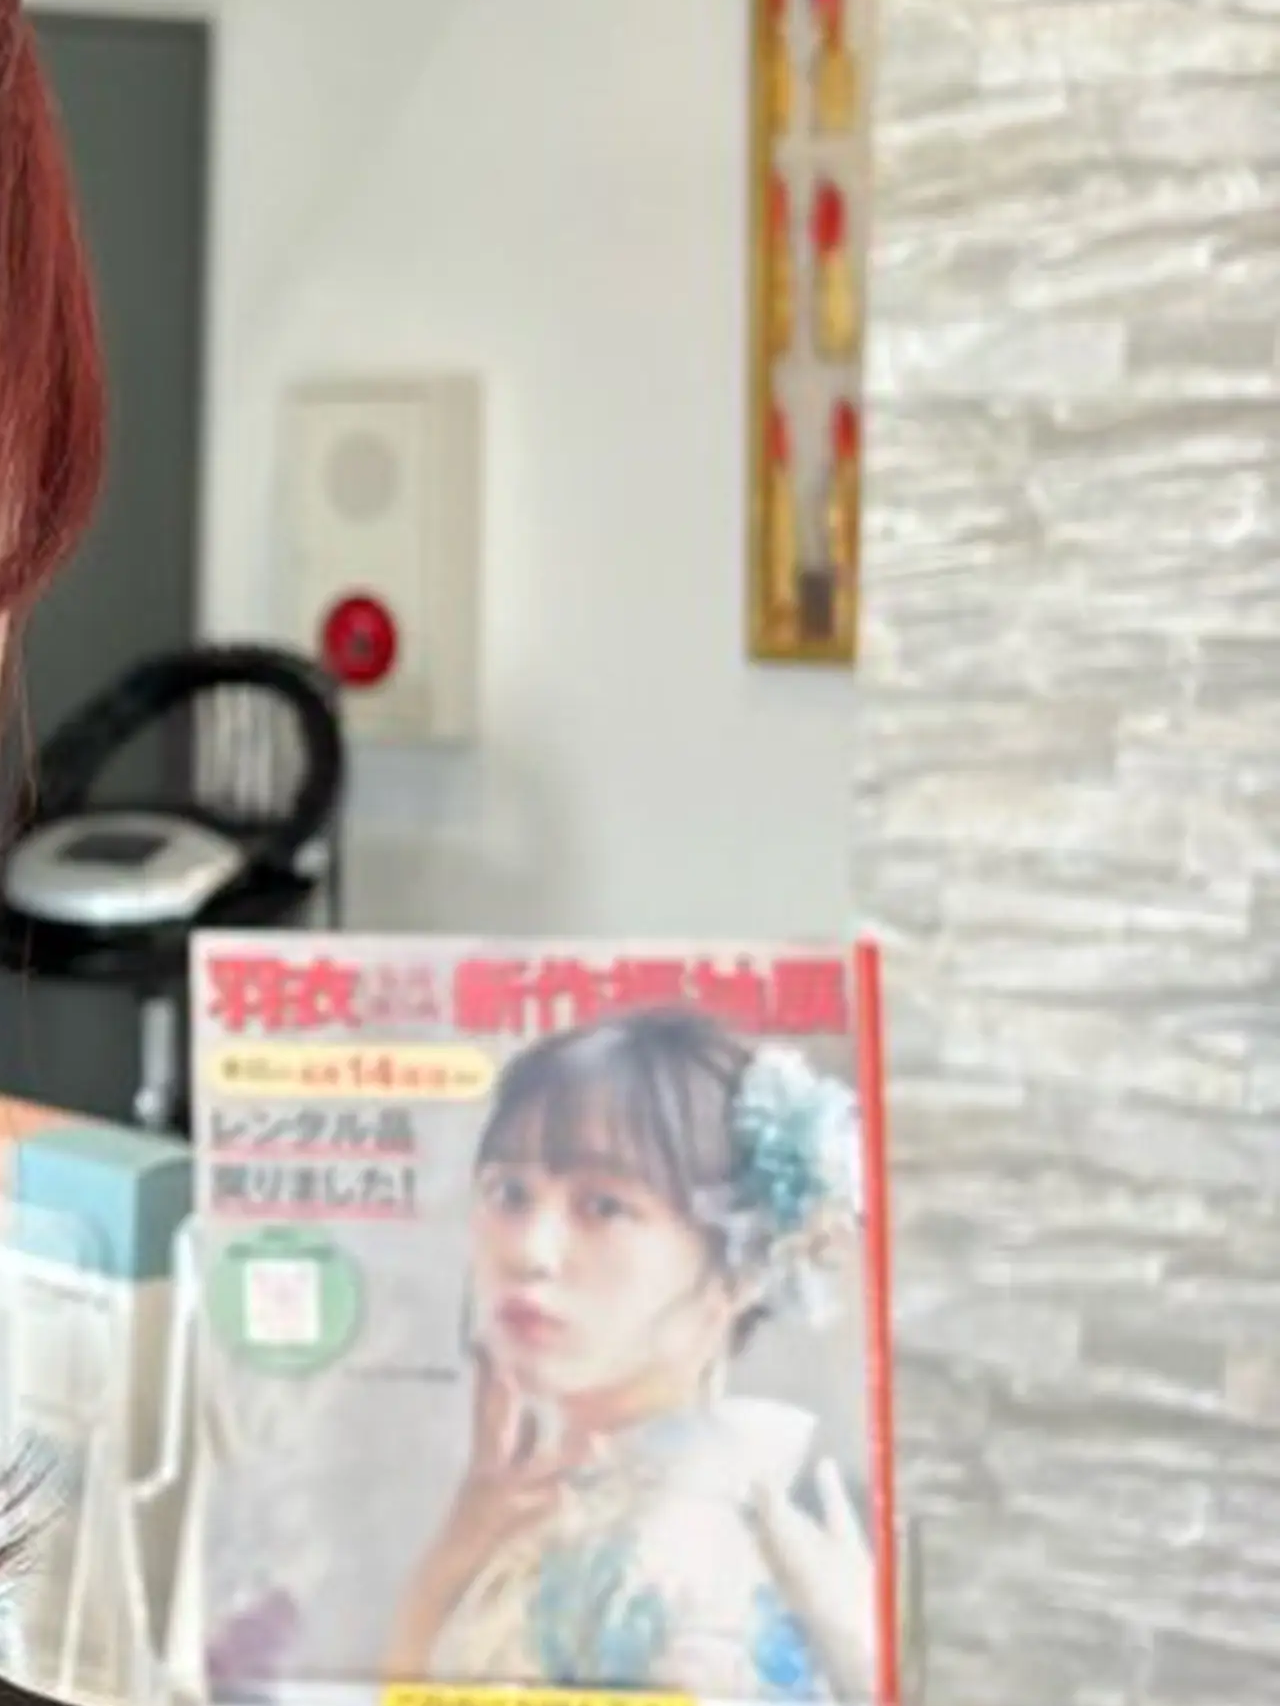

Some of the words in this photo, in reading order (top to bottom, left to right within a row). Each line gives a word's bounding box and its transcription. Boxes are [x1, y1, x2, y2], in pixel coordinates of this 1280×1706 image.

[207, 955, 362, 1033] 羽衣
[210, 1107, 416, 1153] レンタル品
